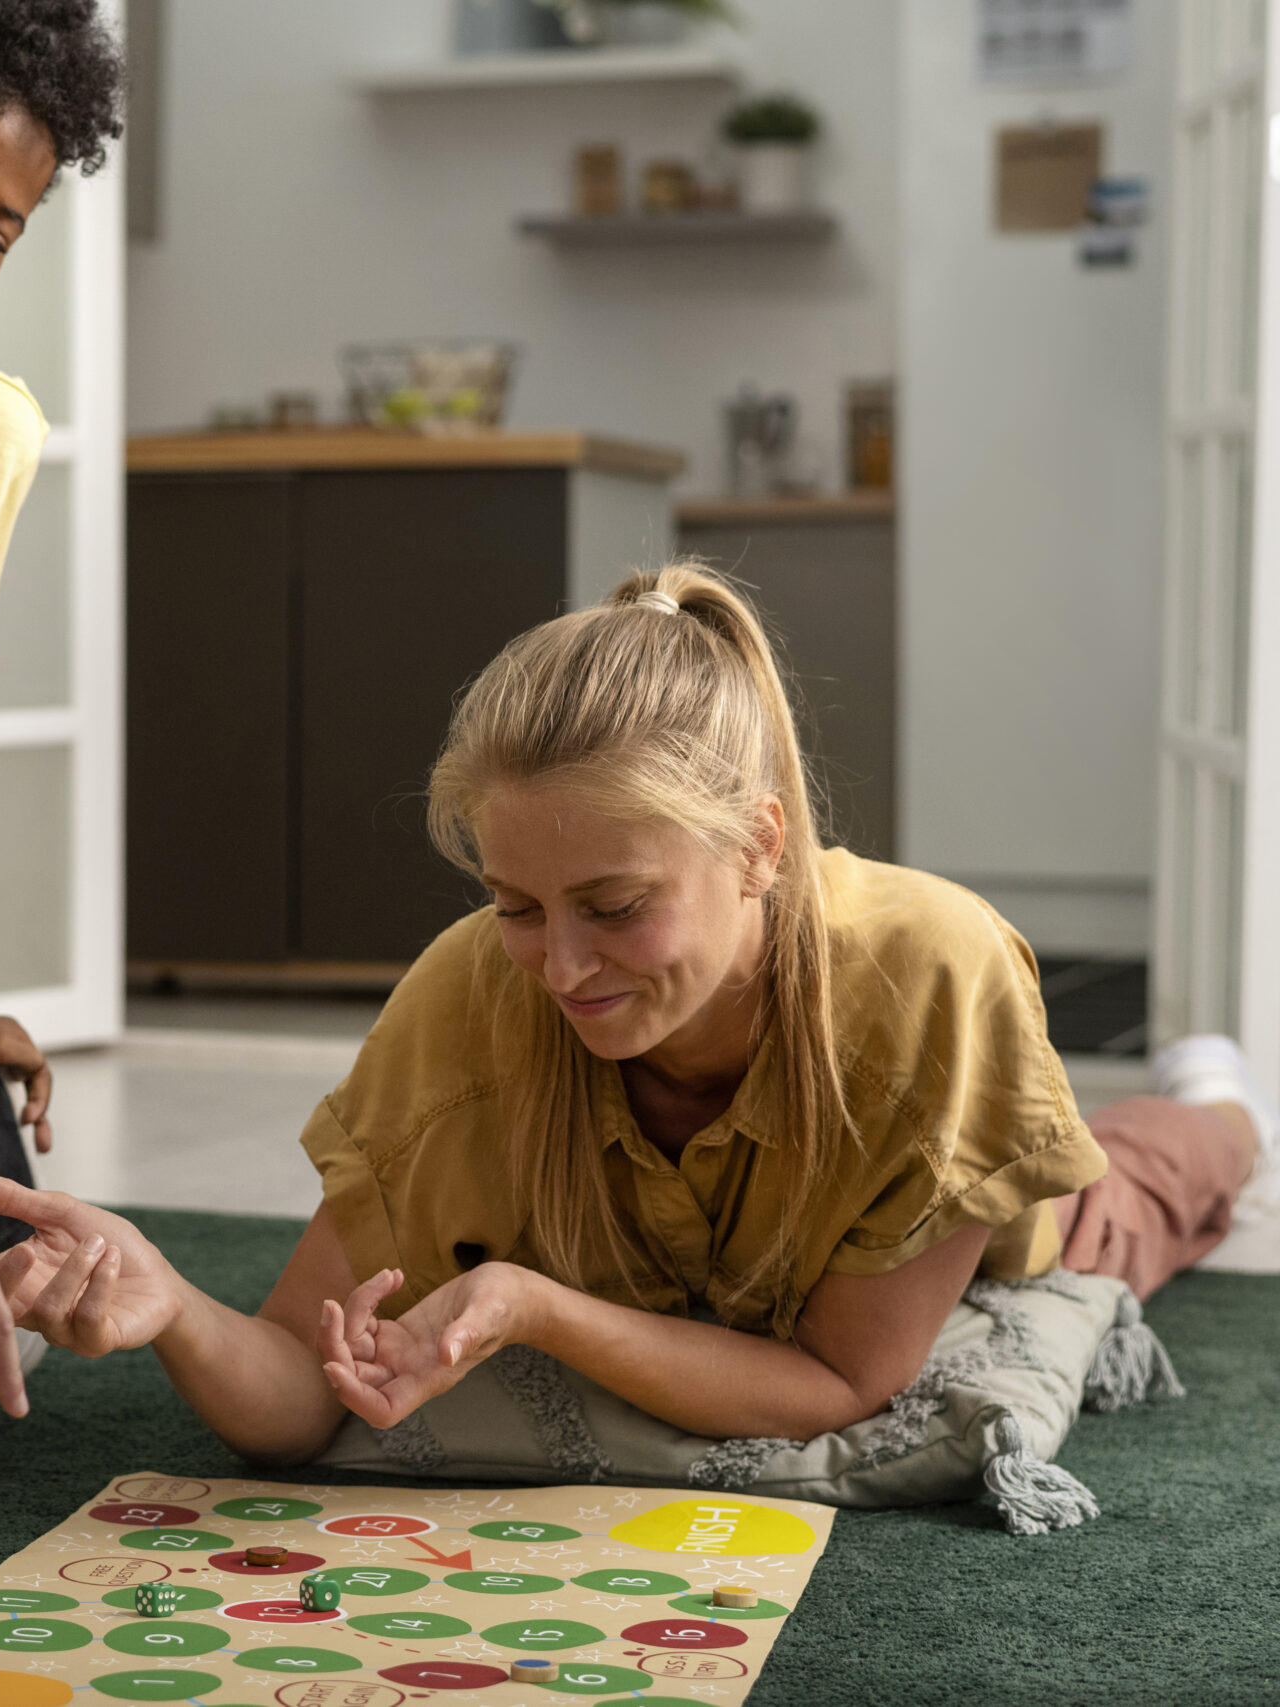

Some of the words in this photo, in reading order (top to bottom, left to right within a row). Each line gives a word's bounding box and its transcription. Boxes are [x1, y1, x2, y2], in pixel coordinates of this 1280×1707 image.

[244, 1503, 288, 1516] 24
[354, 1520, 397, 1533] 25
[152, 1535, 199, 1548] 22
[89, 1564, 114, 1578] FREE
[345, 1572, 391, 1589] 20
[481, 1576, 524, 1588] 19
[258, 1606, 304, 1618] 13
[384, 1618, 431, 1632] 14
[4, 1627, 53, 1643] 10
[144, 1633, 184, 1645] 9
[519, 1629, 564, 1642] 15
[660, 1628, 706, 1641] 16
[275, 1658, 318, 1667] 8
[563, 1673, 607, 1686] 6
